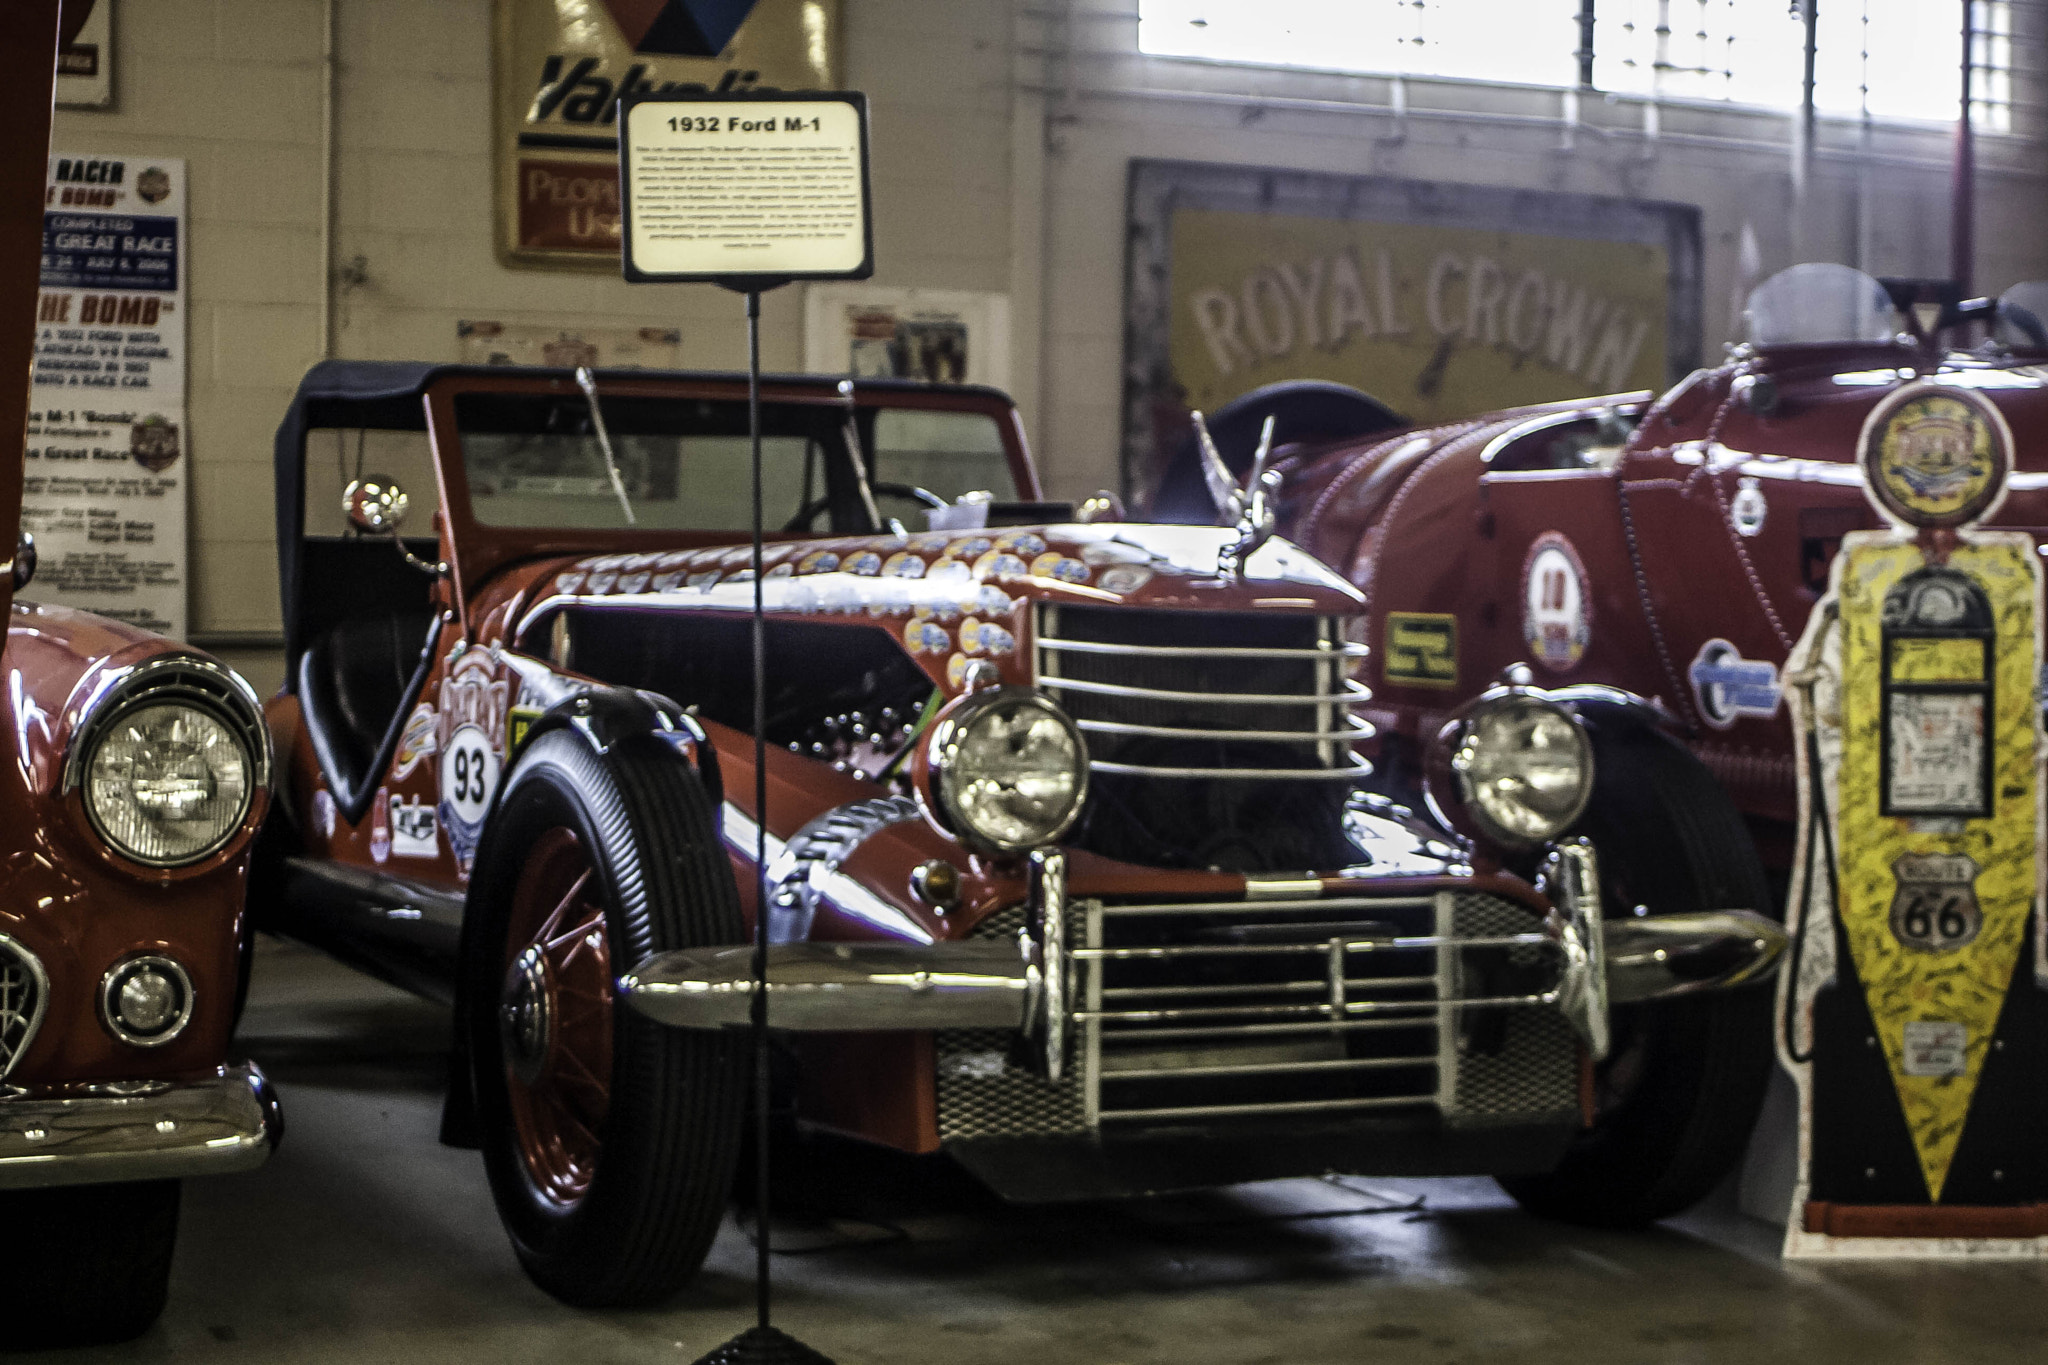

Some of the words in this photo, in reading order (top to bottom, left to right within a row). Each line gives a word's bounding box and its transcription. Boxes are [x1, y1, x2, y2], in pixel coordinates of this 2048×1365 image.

[667, 117, 720, 132] 1932
[728, 117, 776, 132] Ford
[784, 117, 821, 132] M-1
[55, 232, 117, 251] GREAT
[122, 235, 174, 252] RACE
[1195, 246, 1407, 375] ROYAL
[1424, 251, 1650, 393] CROWN
[454, 747, 485, 804] 93
[1905, 895, 1966, 939] 66
